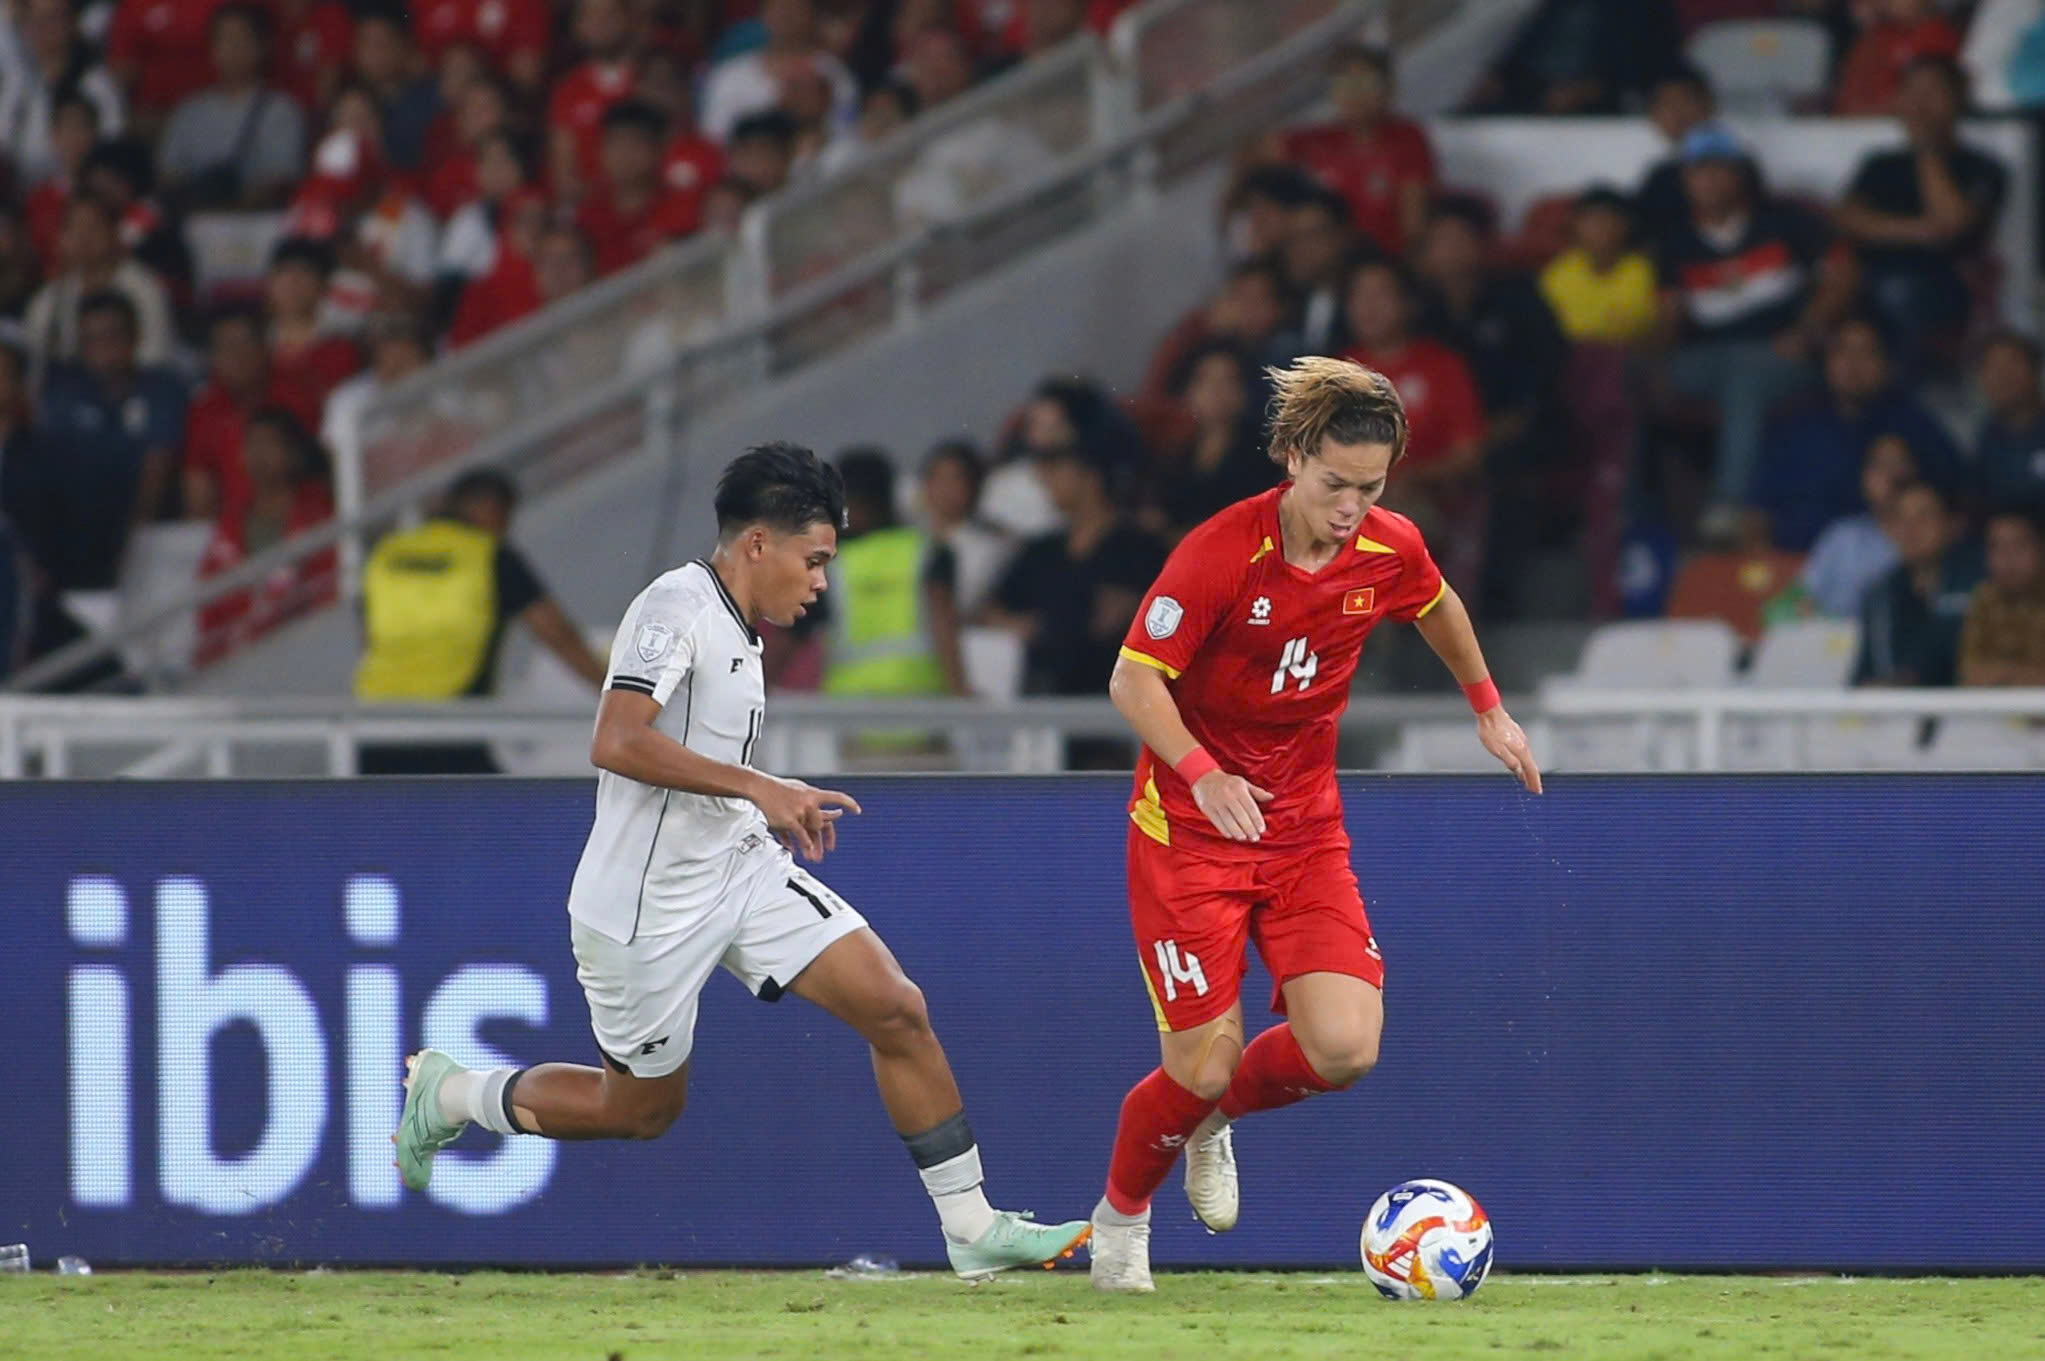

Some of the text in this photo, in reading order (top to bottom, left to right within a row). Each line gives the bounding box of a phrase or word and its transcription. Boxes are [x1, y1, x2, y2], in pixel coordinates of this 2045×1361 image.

[1270, 636, 1318, 694] 14
[1153, 939, 1209, 1002] 14
[66, 873, 558, 1215] ibis
